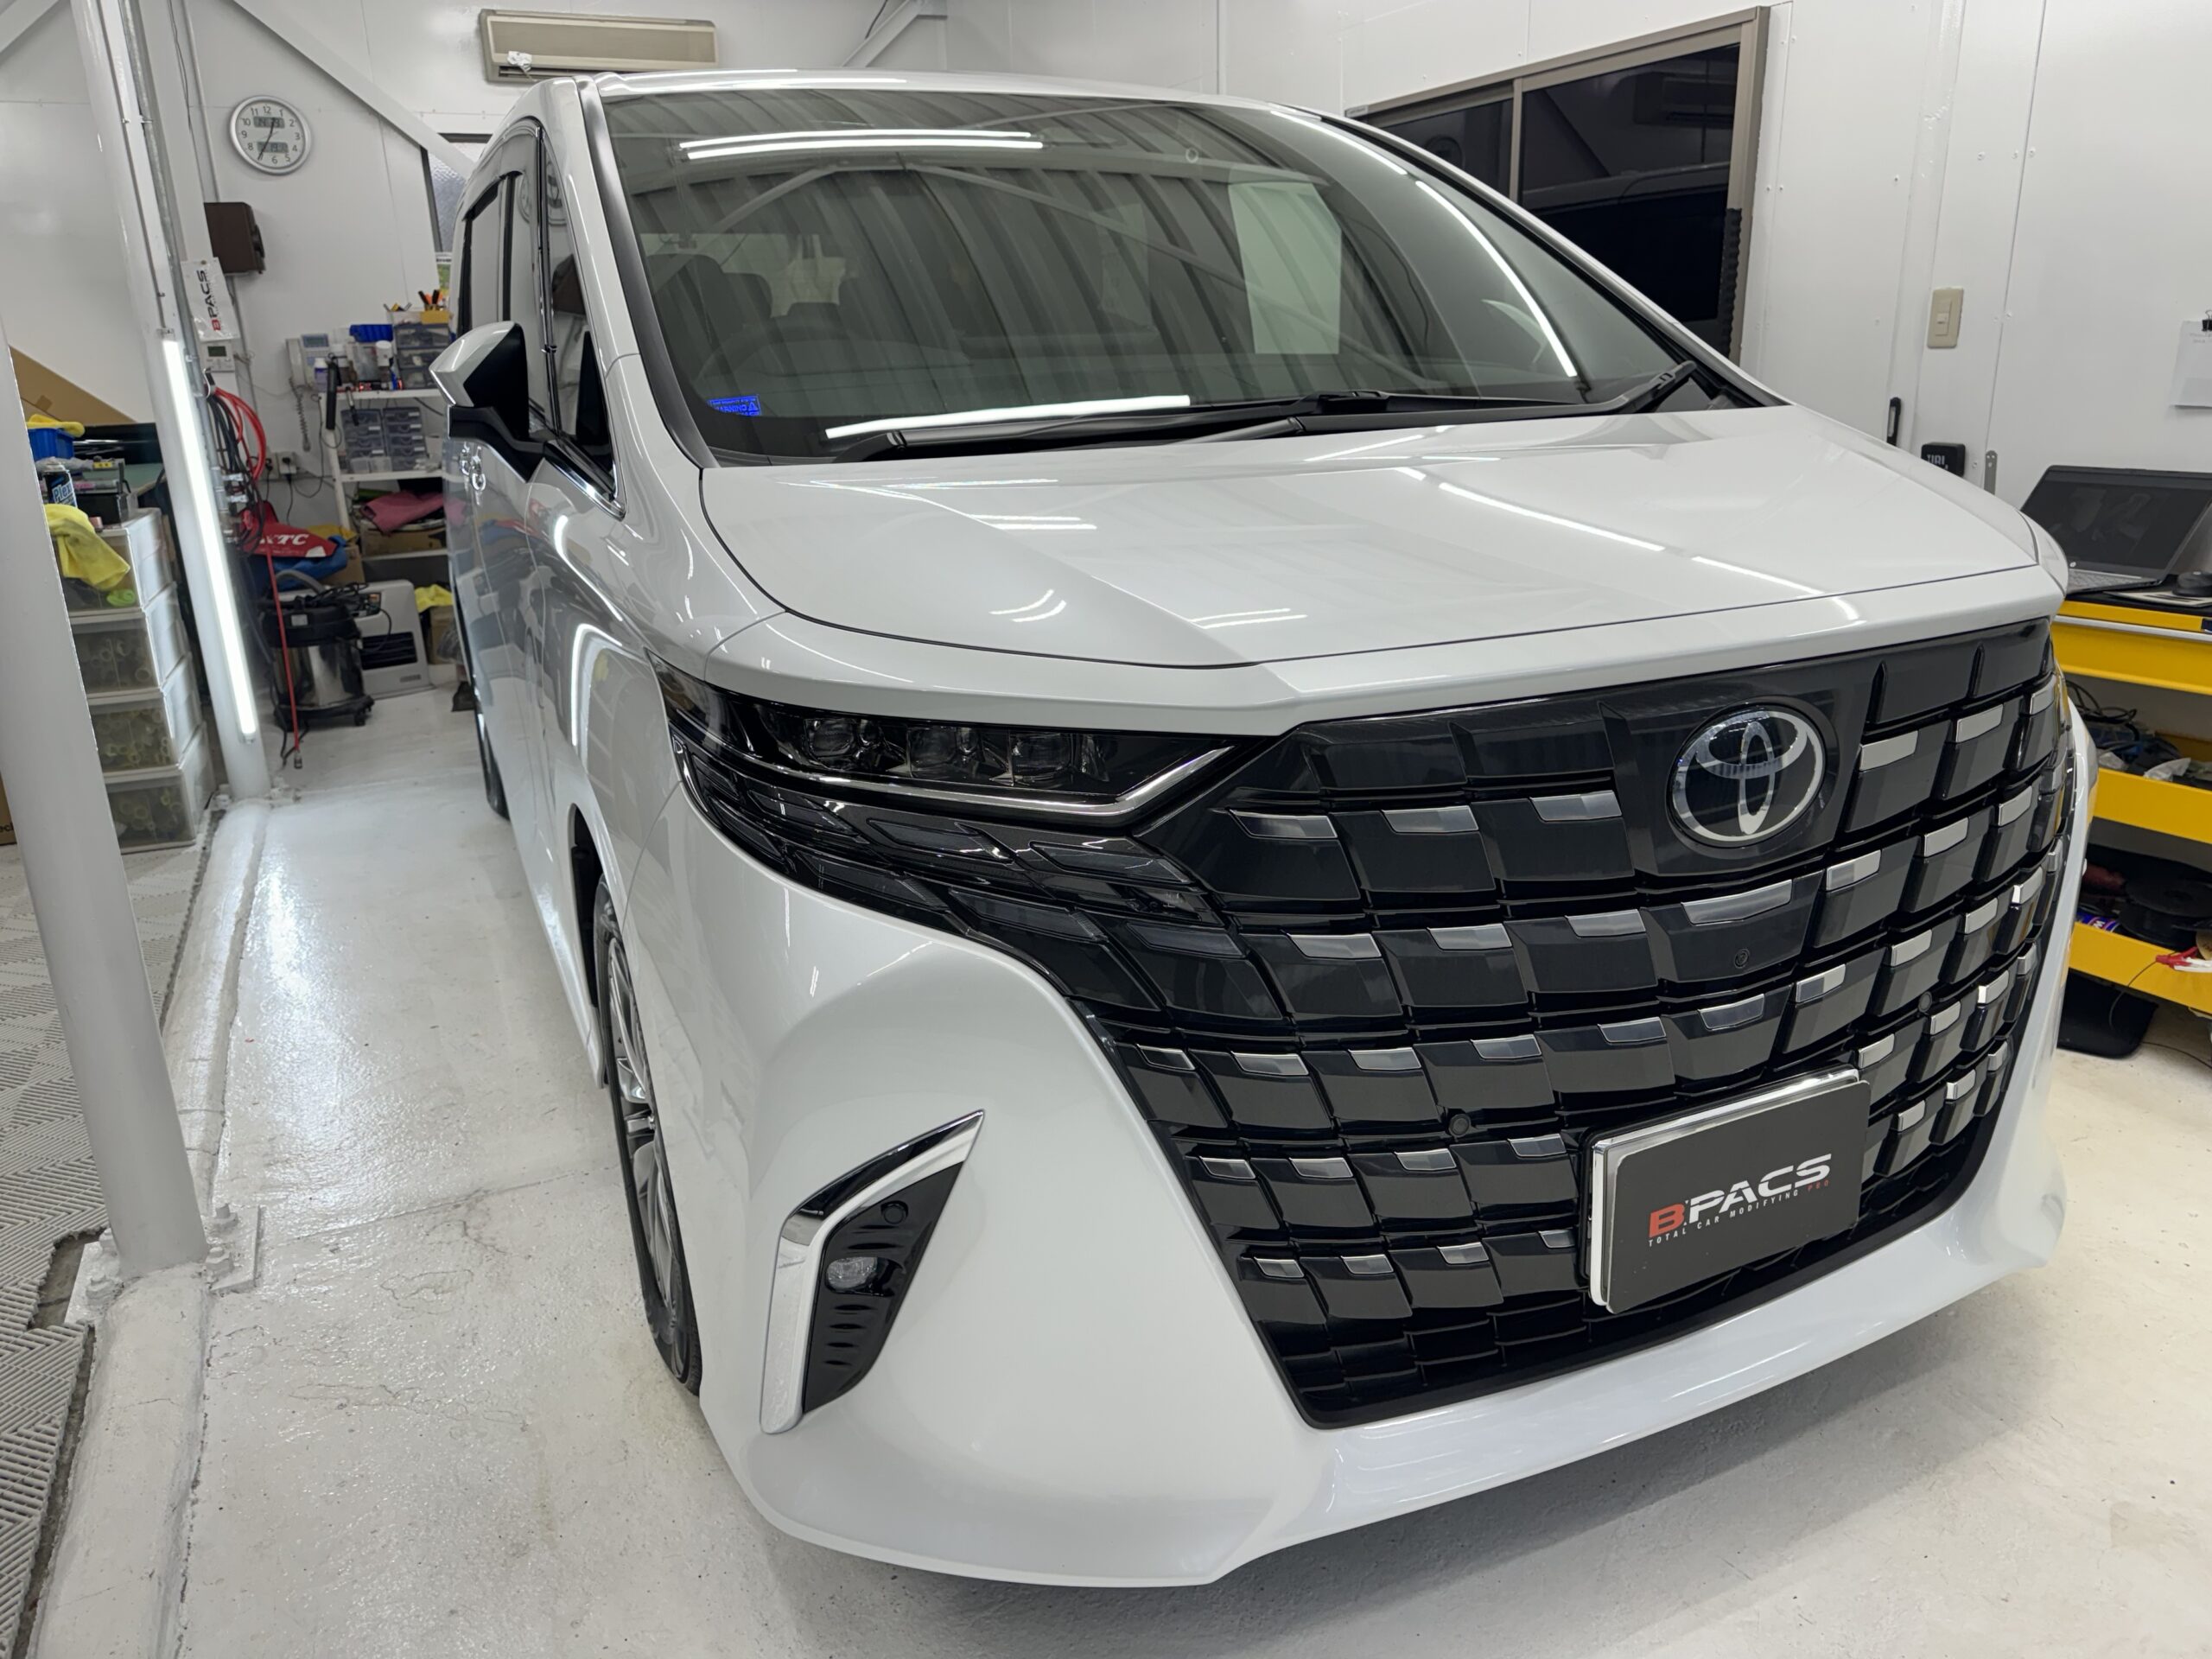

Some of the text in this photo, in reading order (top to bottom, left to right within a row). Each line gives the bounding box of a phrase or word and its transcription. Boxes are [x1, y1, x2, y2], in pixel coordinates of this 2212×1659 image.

[251, 107, 258, 117] 11
[263, 105, 271, 114] 12
[279, 109, 283, 118] 1
[242, 118, 251, 126] 10
[289, 118, 295, 127] 2
[241, 130, 247, 139] 9
[247, 143, 254, 151] 8
[284, 154, 291, 162] 5
[196, 270, 221, 331] BPACS
[1649, 1154, 1832, 1238] BPACS
[1649, 1179, 1829, 1247] TOTAL CAR MODIFYING PRO
